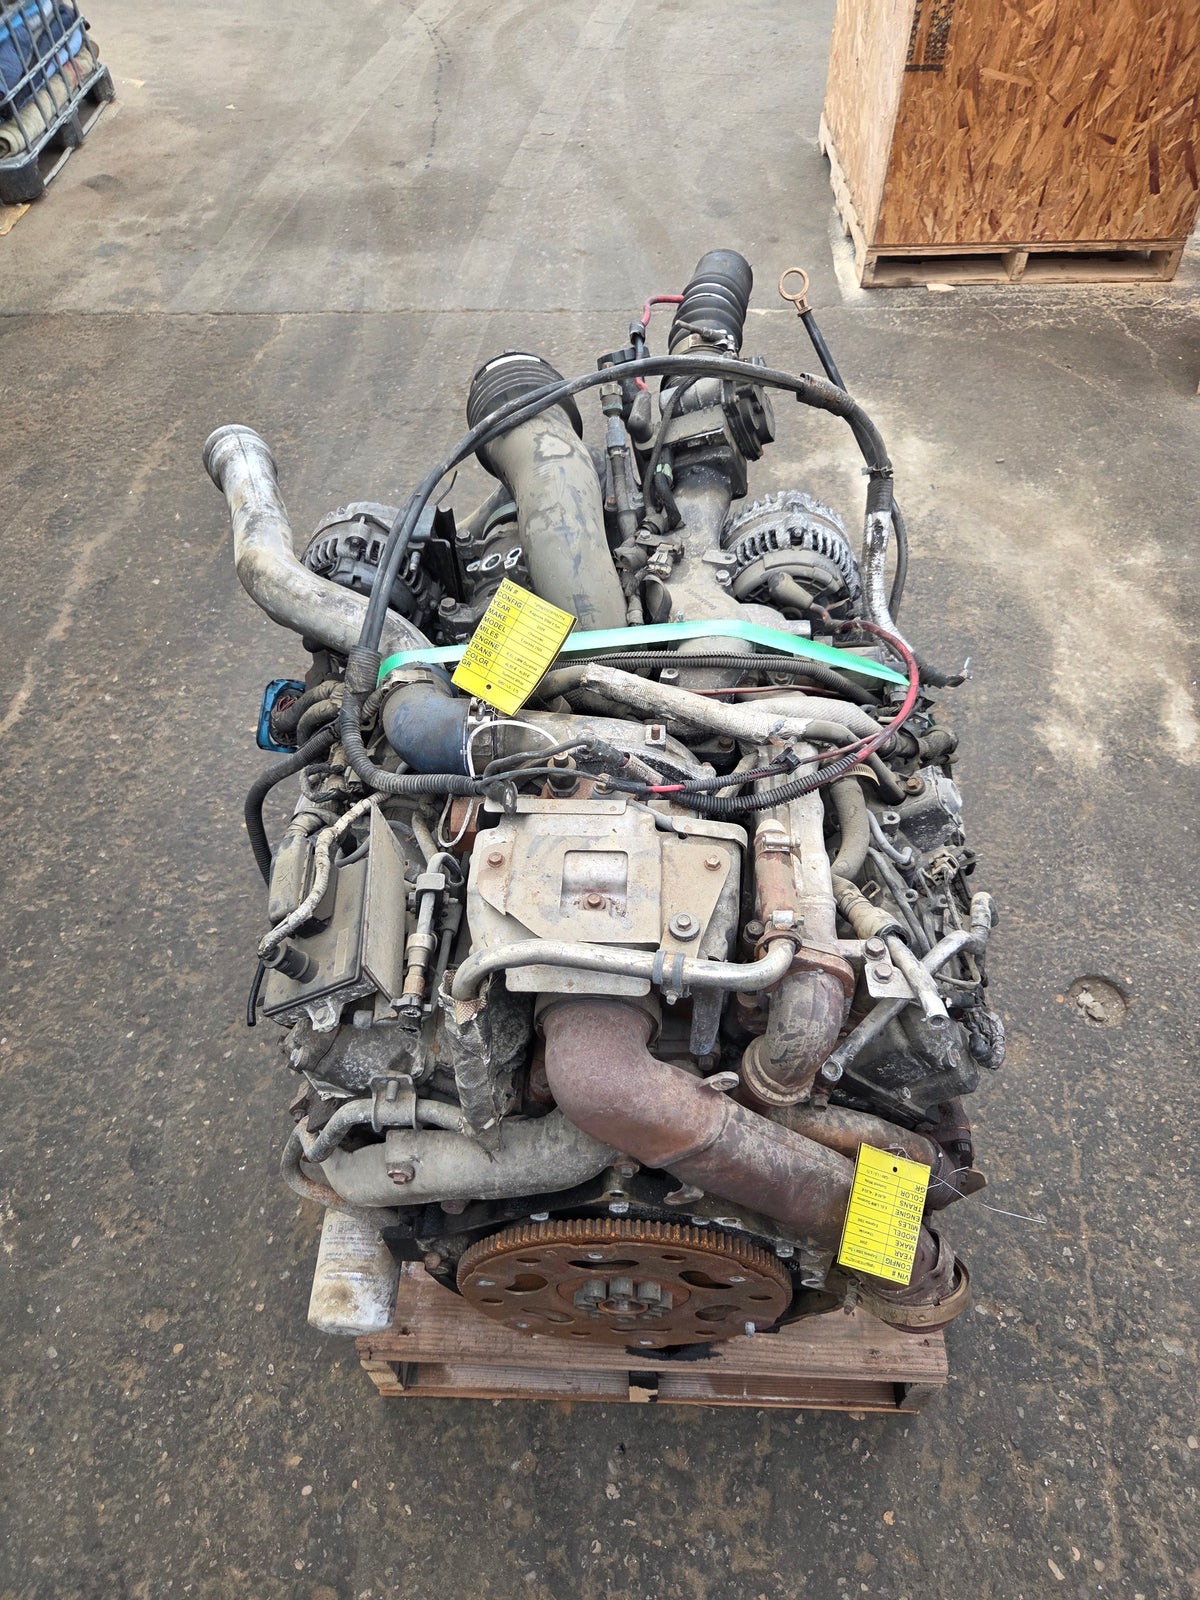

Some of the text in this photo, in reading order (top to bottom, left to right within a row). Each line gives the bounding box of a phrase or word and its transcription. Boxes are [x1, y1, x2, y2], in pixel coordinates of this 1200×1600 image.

[501, 582, 512, 591] VIN
[493, 599, 510, 611] YEAR
[497, 591, 522, 608] CONFIG
[488, 608, 507, 622] MAKE
[483, 617, 506, 632] MODEL
[479, 625, 499, 639] MILES
[474, 633, 498, 649] ENGINE
[470, 642, 492, 657] TRANS
[466, 651, 489, 666] COLOR
[900, 1191, 924, 1202] COLOR
[899, 1201, 922, 1211] TRANS
[896, 1209, 920, 1220] ENGINE
[898, 1221, 919, 1230] MILES
[894, 1229, 916, 1240] MODEL
[895, 1240, 914, 1250] MAKE
[894, 1250, 913, 1259] YEAR
[885, 1259, 911, 1270] CONFIG
[897, 1272, 909, 1280] VIN
